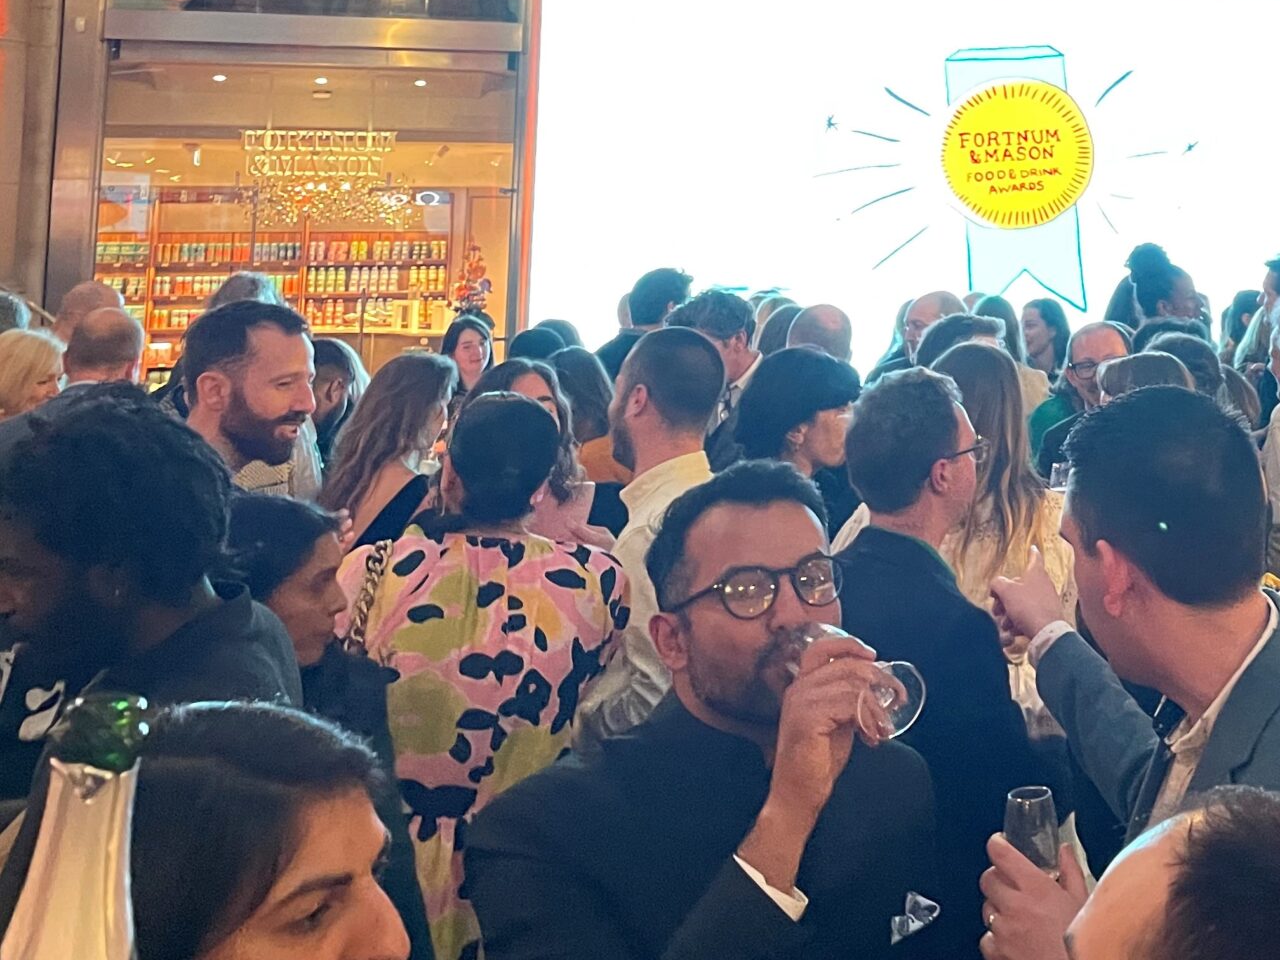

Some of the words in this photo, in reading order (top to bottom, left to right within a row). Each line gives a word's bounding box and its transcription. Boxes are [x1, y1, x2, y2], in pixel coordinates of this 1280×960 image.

[243, 129, 397, 152] FORTNUM
[958, 129, 1061, 149] FORTNUM
[966, 170, 1006, 183] FOOD
[989, 180, 1044, 195] AWARDS
